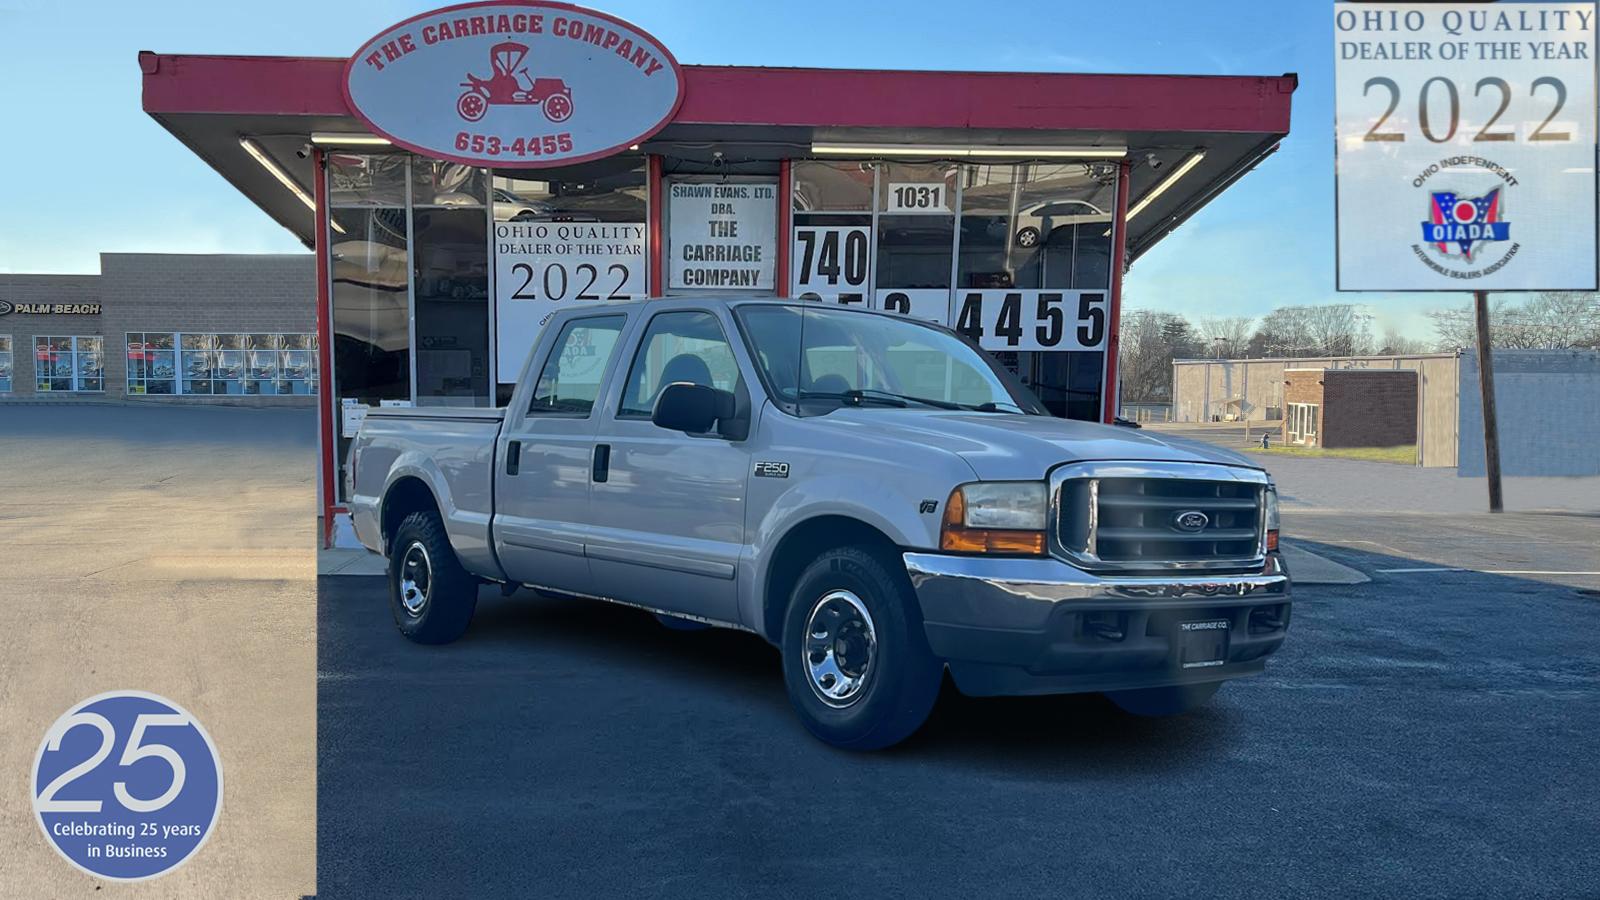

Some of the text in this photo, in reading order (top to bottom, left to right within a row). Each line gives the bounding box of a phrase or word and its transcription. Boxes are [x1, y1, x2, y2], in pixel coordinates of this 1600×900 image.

[1336, 10, 1593, 36] OHIO QUALITY
[365, 14, 665, 77] THE CARRIAGE COMPANY
[1340, 41, 1589, 60] DEALER OF THE YEAR
[1363, 76, 1571, 143] 2022
[455, 132, 573, 156] 653-4455
[1412, 156, 1519, 188] OHIO INDEPENDENT
[673, 186, 712, 199] SHAWN
[754, 186, 775, 199] LTD.
[895, 186, 940, 208] 1031
[711, 203, 736, 215] DBA.
[497, 226, 644, 241] OHIO QUALITY
[709, 220, 738, 238] THE
[1433, 224, 1495, 240] OIADA
[500, 243, 642, 255] DEALER OF THE YEAR
[683, 244, 762, 262] CARRIAGE
[797, 230, 868, 285] 740
[1411, 242, 1520, 280] AUTOMOBILE DEALERS ASSOCIATION
[511, 263, 631, 300] 2022
[683, 268, 760, 287] COMPANY
[15, 304, 100, 314] PALM BEACH
[754, 462, 788, 474] F250
[1185, 515, 1202, 527] Ford
